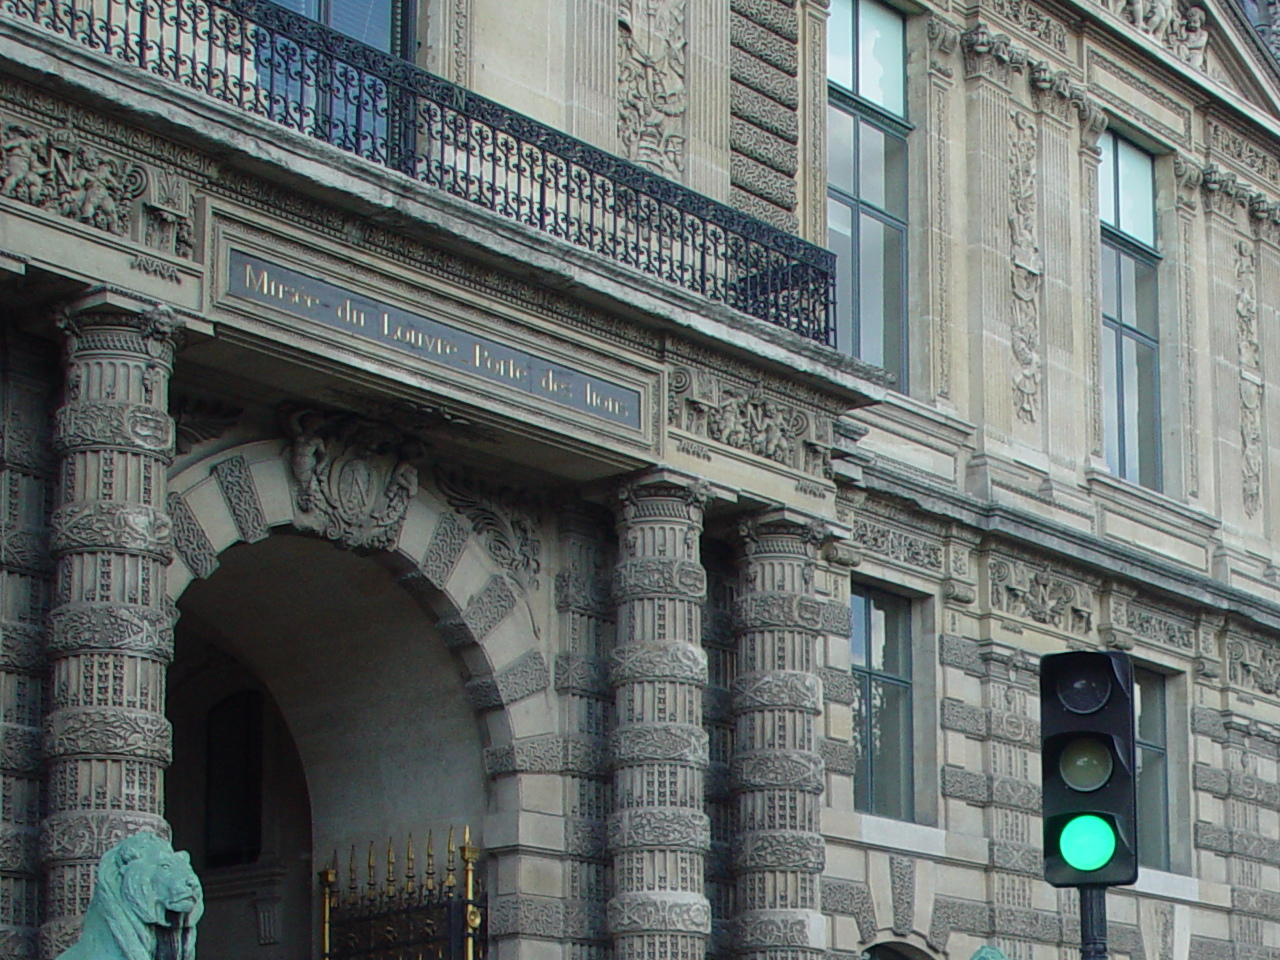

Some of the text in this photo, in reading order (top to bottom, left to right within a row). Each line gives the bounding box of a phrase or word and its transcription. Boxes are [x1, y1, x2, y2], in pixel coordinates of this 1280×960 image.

[245, 263, 320, 308] Musée
[337, 299, 365, 327] du
[383, 312, 458, 356] Louvre
[475, 343, 528, 381] Porte
[541, 369, 573, 398] des
